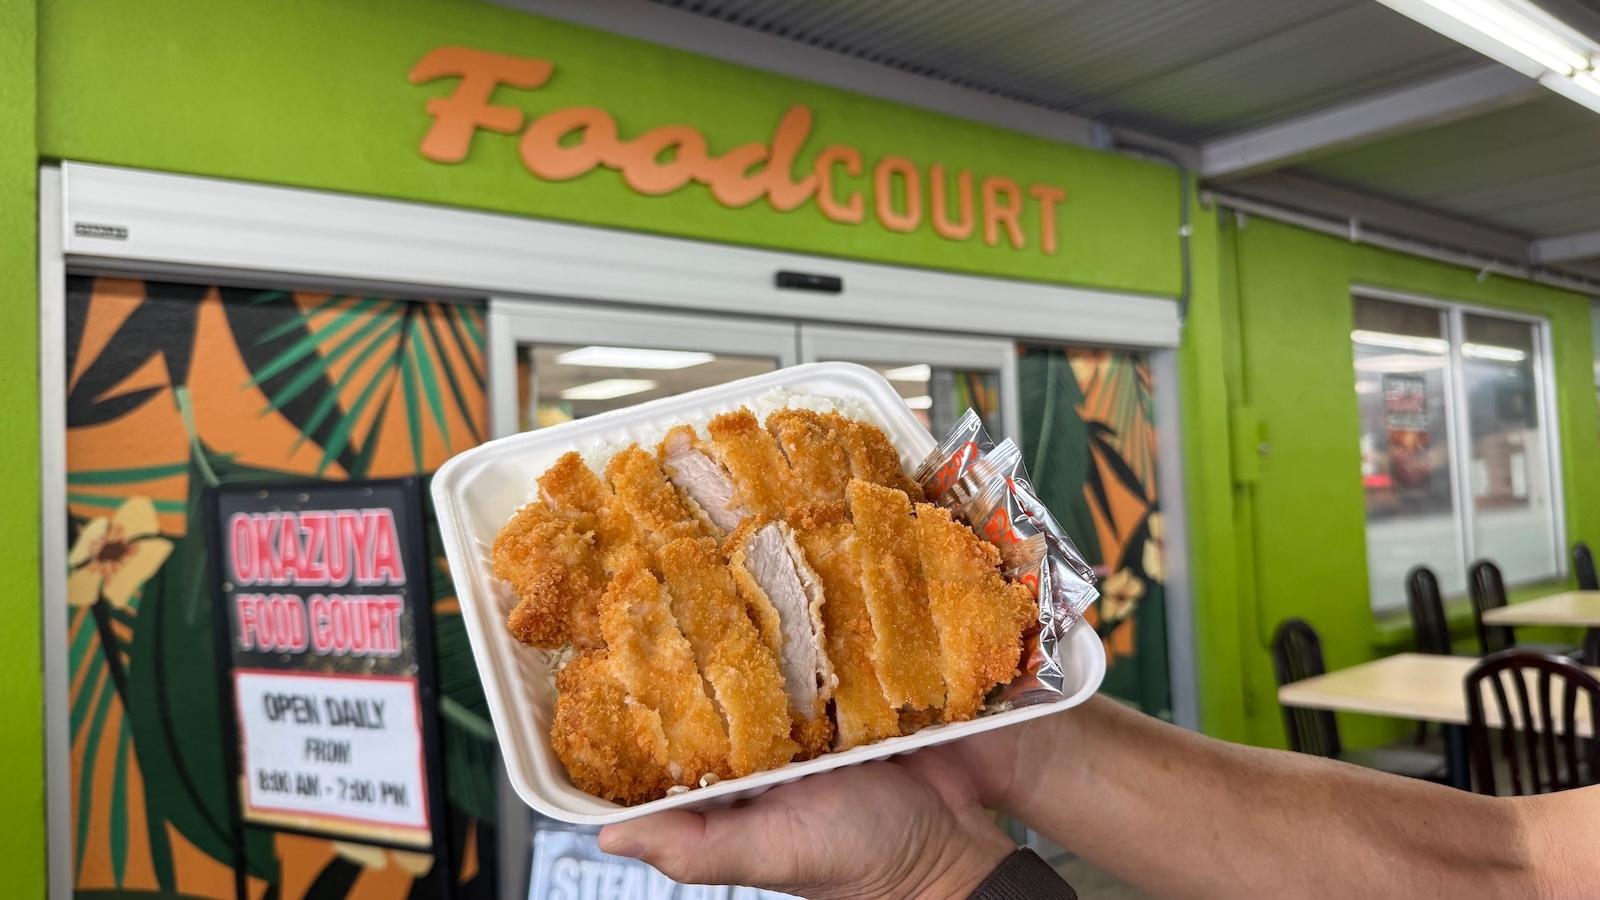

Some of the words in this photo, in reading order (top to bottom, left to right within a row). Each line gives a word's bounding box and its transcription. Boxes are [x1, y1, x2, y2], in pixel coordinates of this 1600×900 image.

[408, 45, 819, 212] Food
[816, 144, 1067, 256] COURT
[229, 508, 406, 586] OKAZUYA
[236, 594, 309, 653] FOOD
[309, 594, 404, 657] COURT
[262, 691, 320, 725] OPEN
[325, 696, 387, 731] DAILY
[304, 736, 352, 766] FROM
[257, 767, 290, 795] 8:00
[295, 773, 323, 799] AM
[381, 781, 409, 808] PM
